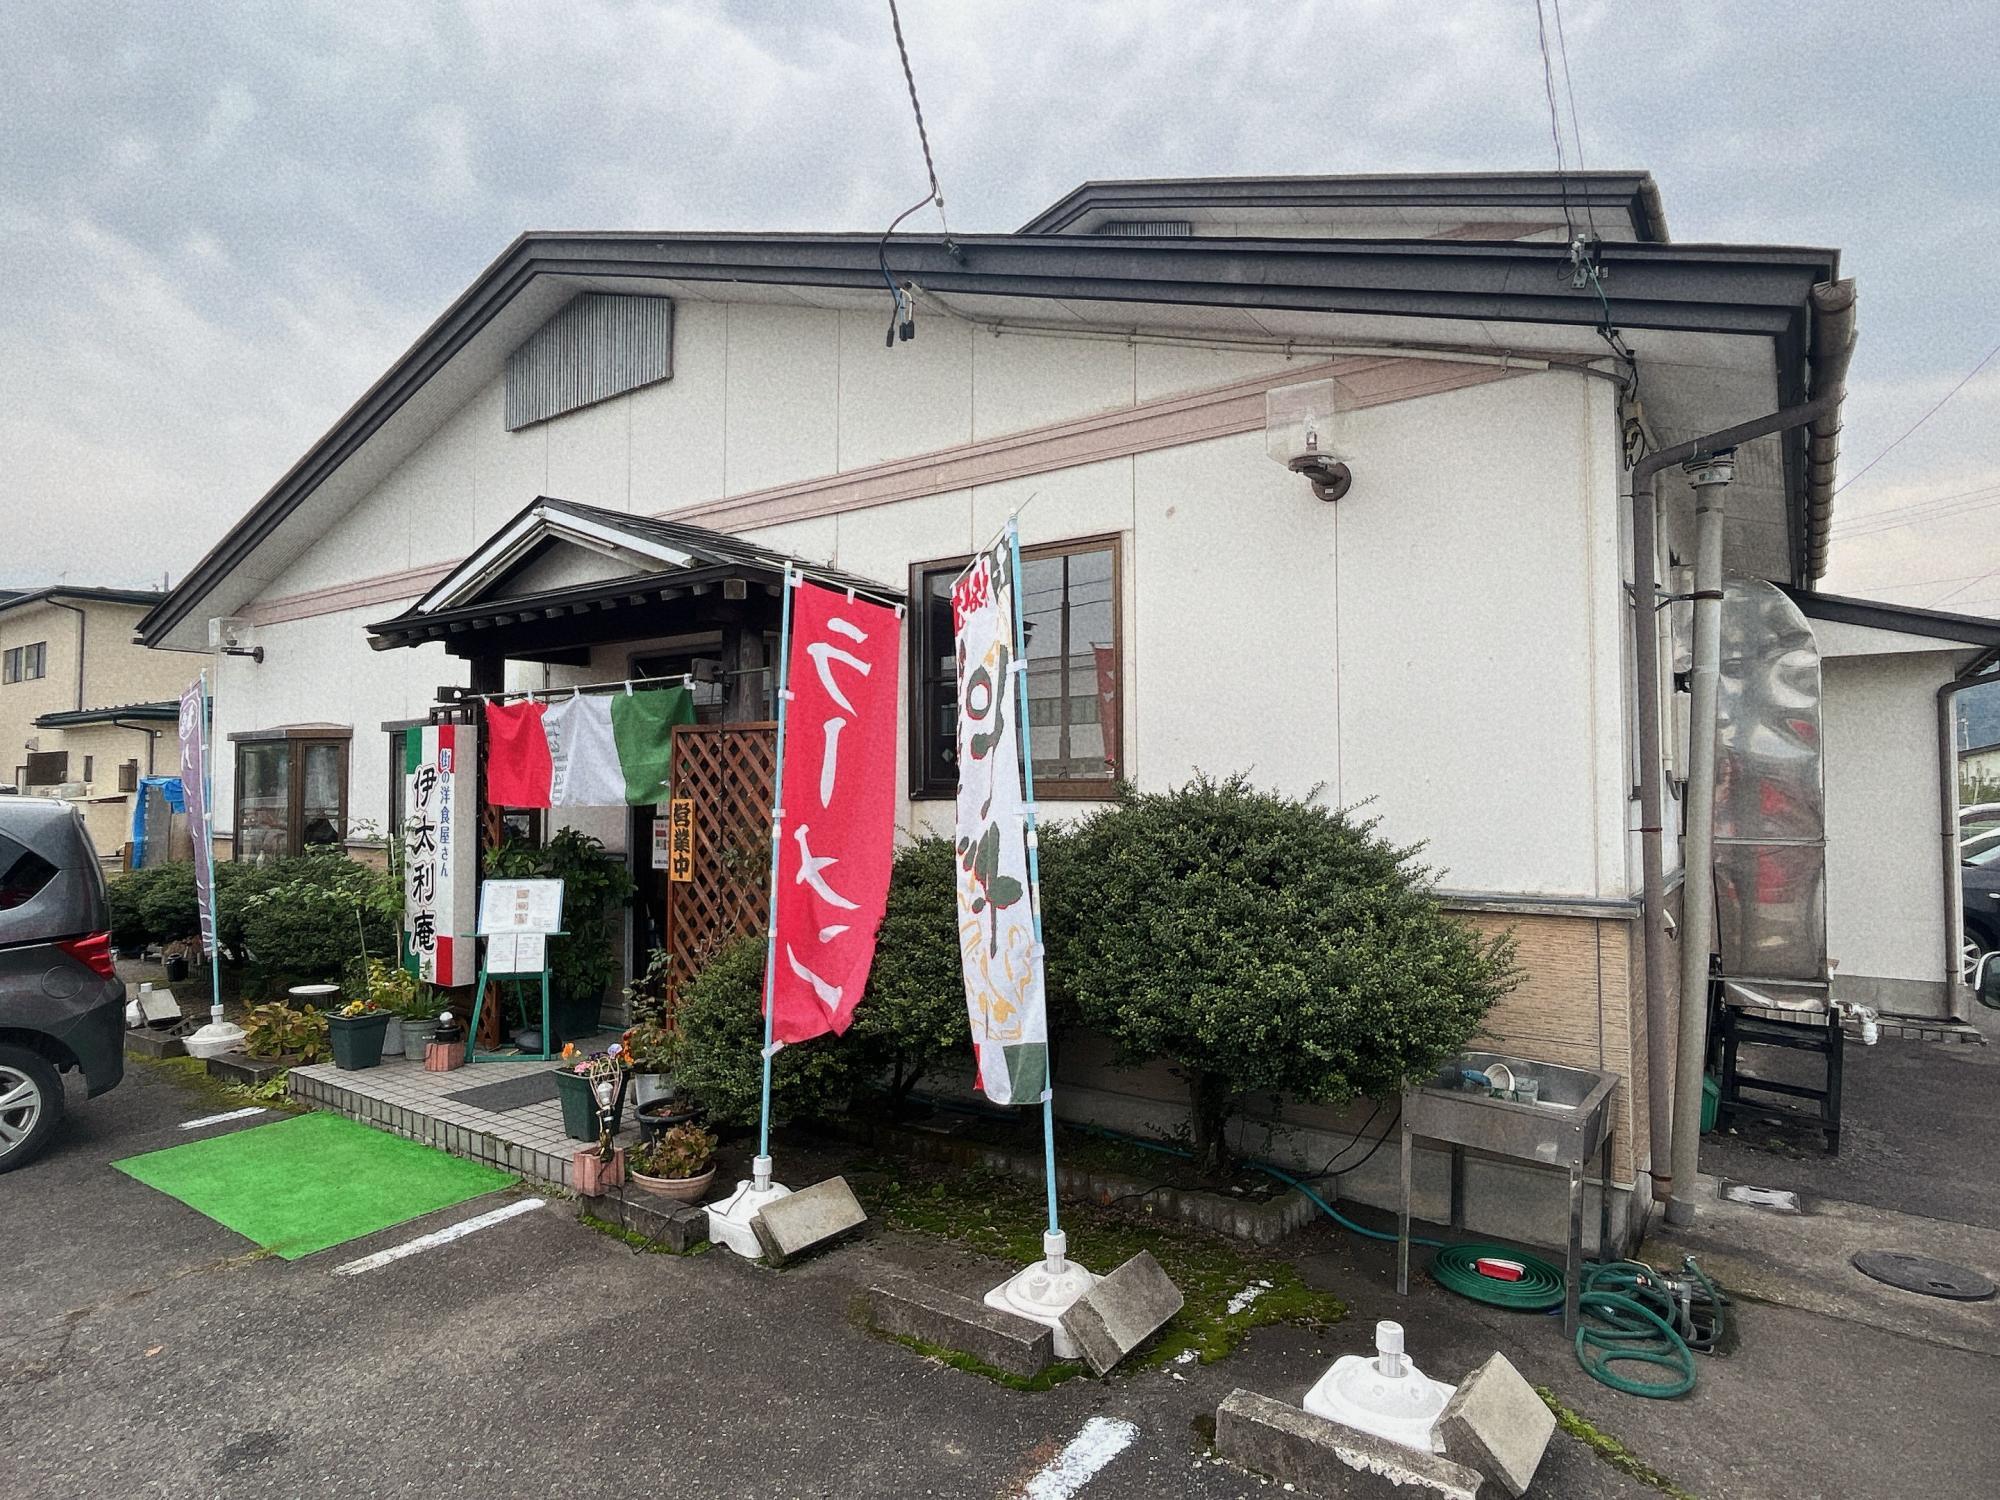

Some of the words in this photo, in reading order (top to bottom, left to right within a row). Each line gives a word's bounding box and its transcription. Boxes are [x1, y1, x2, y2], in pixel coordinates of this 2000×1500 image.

[410, 765, 438, 951] 伊太利庵
[439, 748, 452, 877] 街の洋食屋さん
[673, 802, 691, 879] 営業中
[786, 617, 871, 1013] ラーメン
